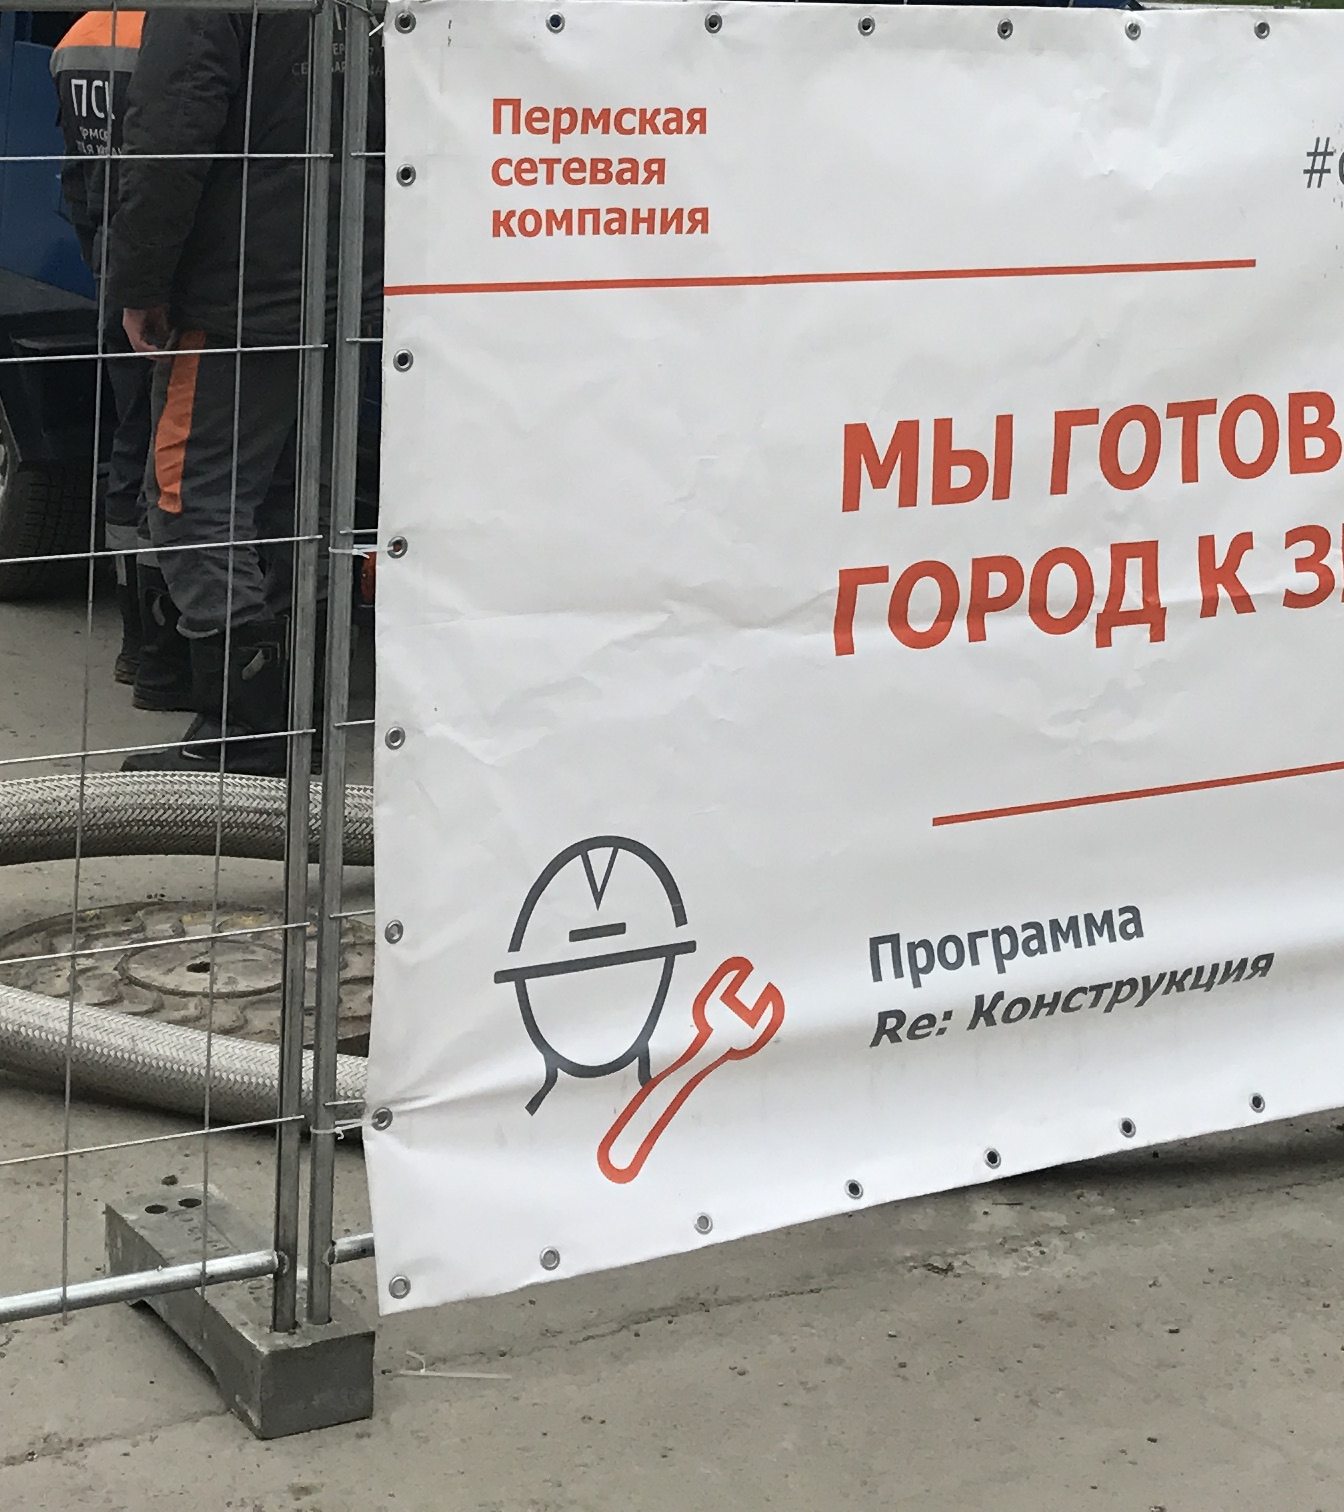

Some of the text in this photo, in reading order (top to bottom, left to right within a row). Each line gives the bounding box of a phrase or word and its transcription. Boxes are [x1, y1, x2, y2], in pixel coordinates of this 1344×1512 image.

[492, 97, 708, 142] Пермская
[491, 156, 666, 187] сетевая
[492, 204, 710, 238] компания
[842, 413, 1013, 512] МЫ
[833, 539, 1167, 657] ГОРОД
[1197, 531, 1257, 619] К
[869, 905, 1145, 988] Программа
[869, 951, 1276, 1048] Re: Конструкция
